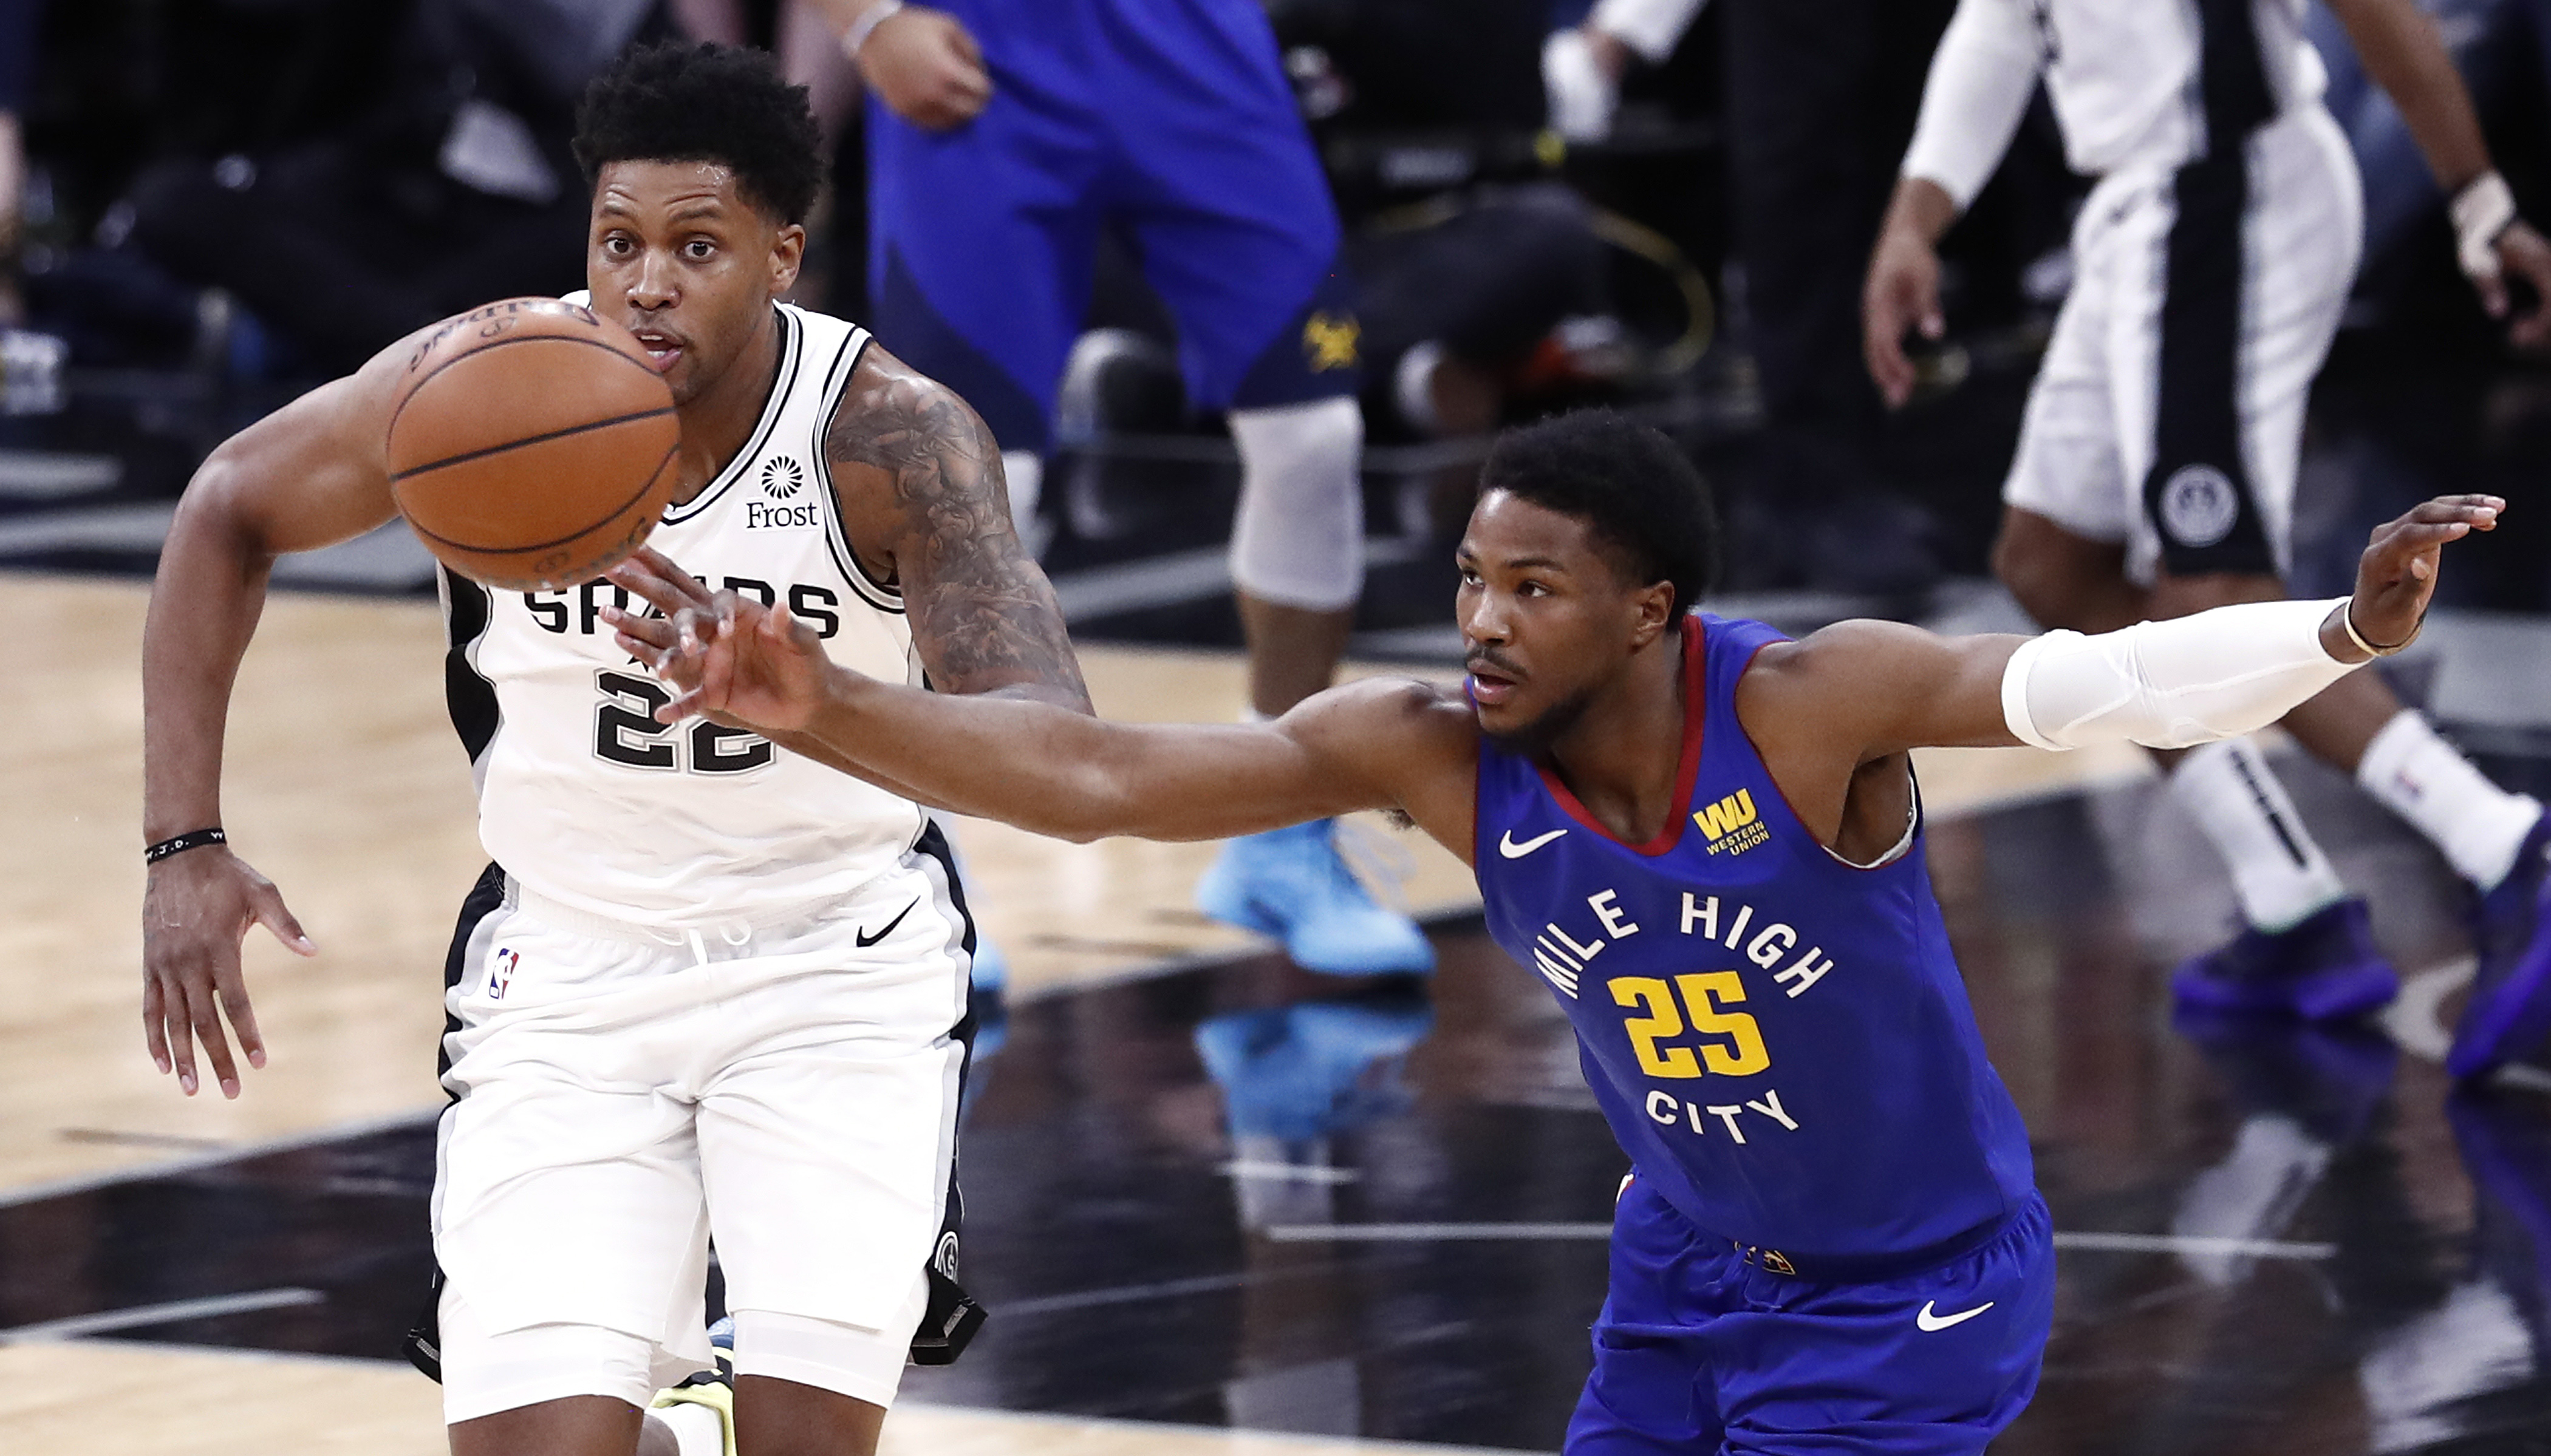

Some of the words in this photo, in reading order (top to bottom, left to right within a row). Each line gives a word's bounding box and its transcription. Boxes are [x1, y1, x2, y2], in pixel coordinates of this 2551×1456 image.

[746, 502, 818, 529] Frost
[1692, 788, 1757, 842] WU
[1706, 820, 1765, 856] WESTERN
[1730, 830, 1770, 856] UNION
[1533, 888, 1639, 999] MILE
[1680, 892, 1834, 999] HIGH
[1607, 970, 1771, 1079] 25
[1645, 1089, 1800, 1145] CITY
